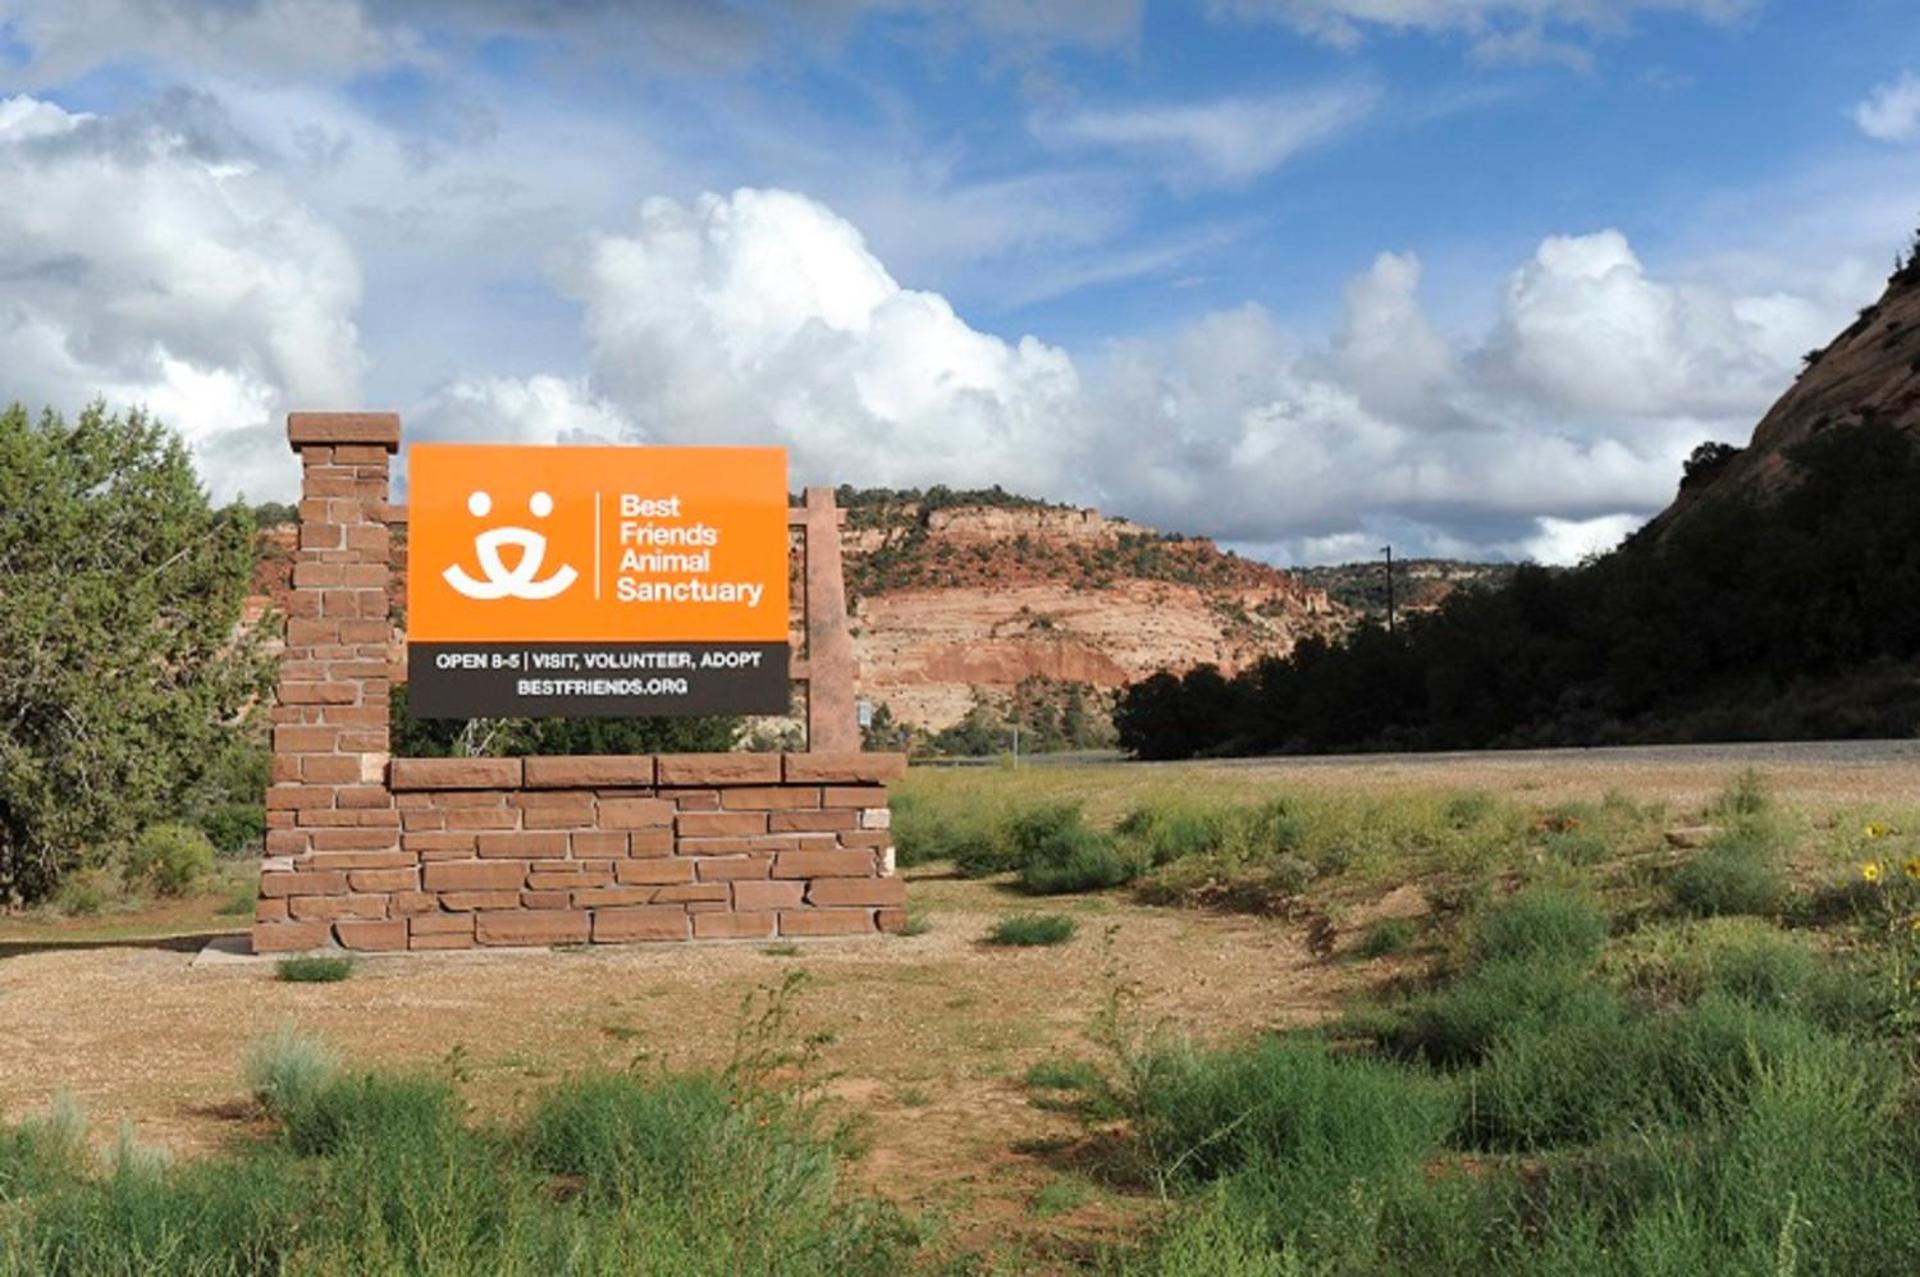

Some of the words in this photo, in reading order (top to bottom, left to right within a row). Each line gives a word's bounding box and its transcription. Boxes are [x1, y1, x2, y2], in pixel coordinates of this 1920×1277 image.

[619, 493, 681, 518] Best
[619, 521, 718, 547] Friends
[618, 548, 711, 573] Animal
[616, 576, 763, 607] Sanctuary
[435, 653, 488, 669] OPEN
[531, 652, 581, 671] VISIT,
[584, 652, 697, 671] VOLUNTEER,
[700, 651, 762, 669] ADOPT
[517, 677, 688, 696] BESTFRIENDS.ORG
